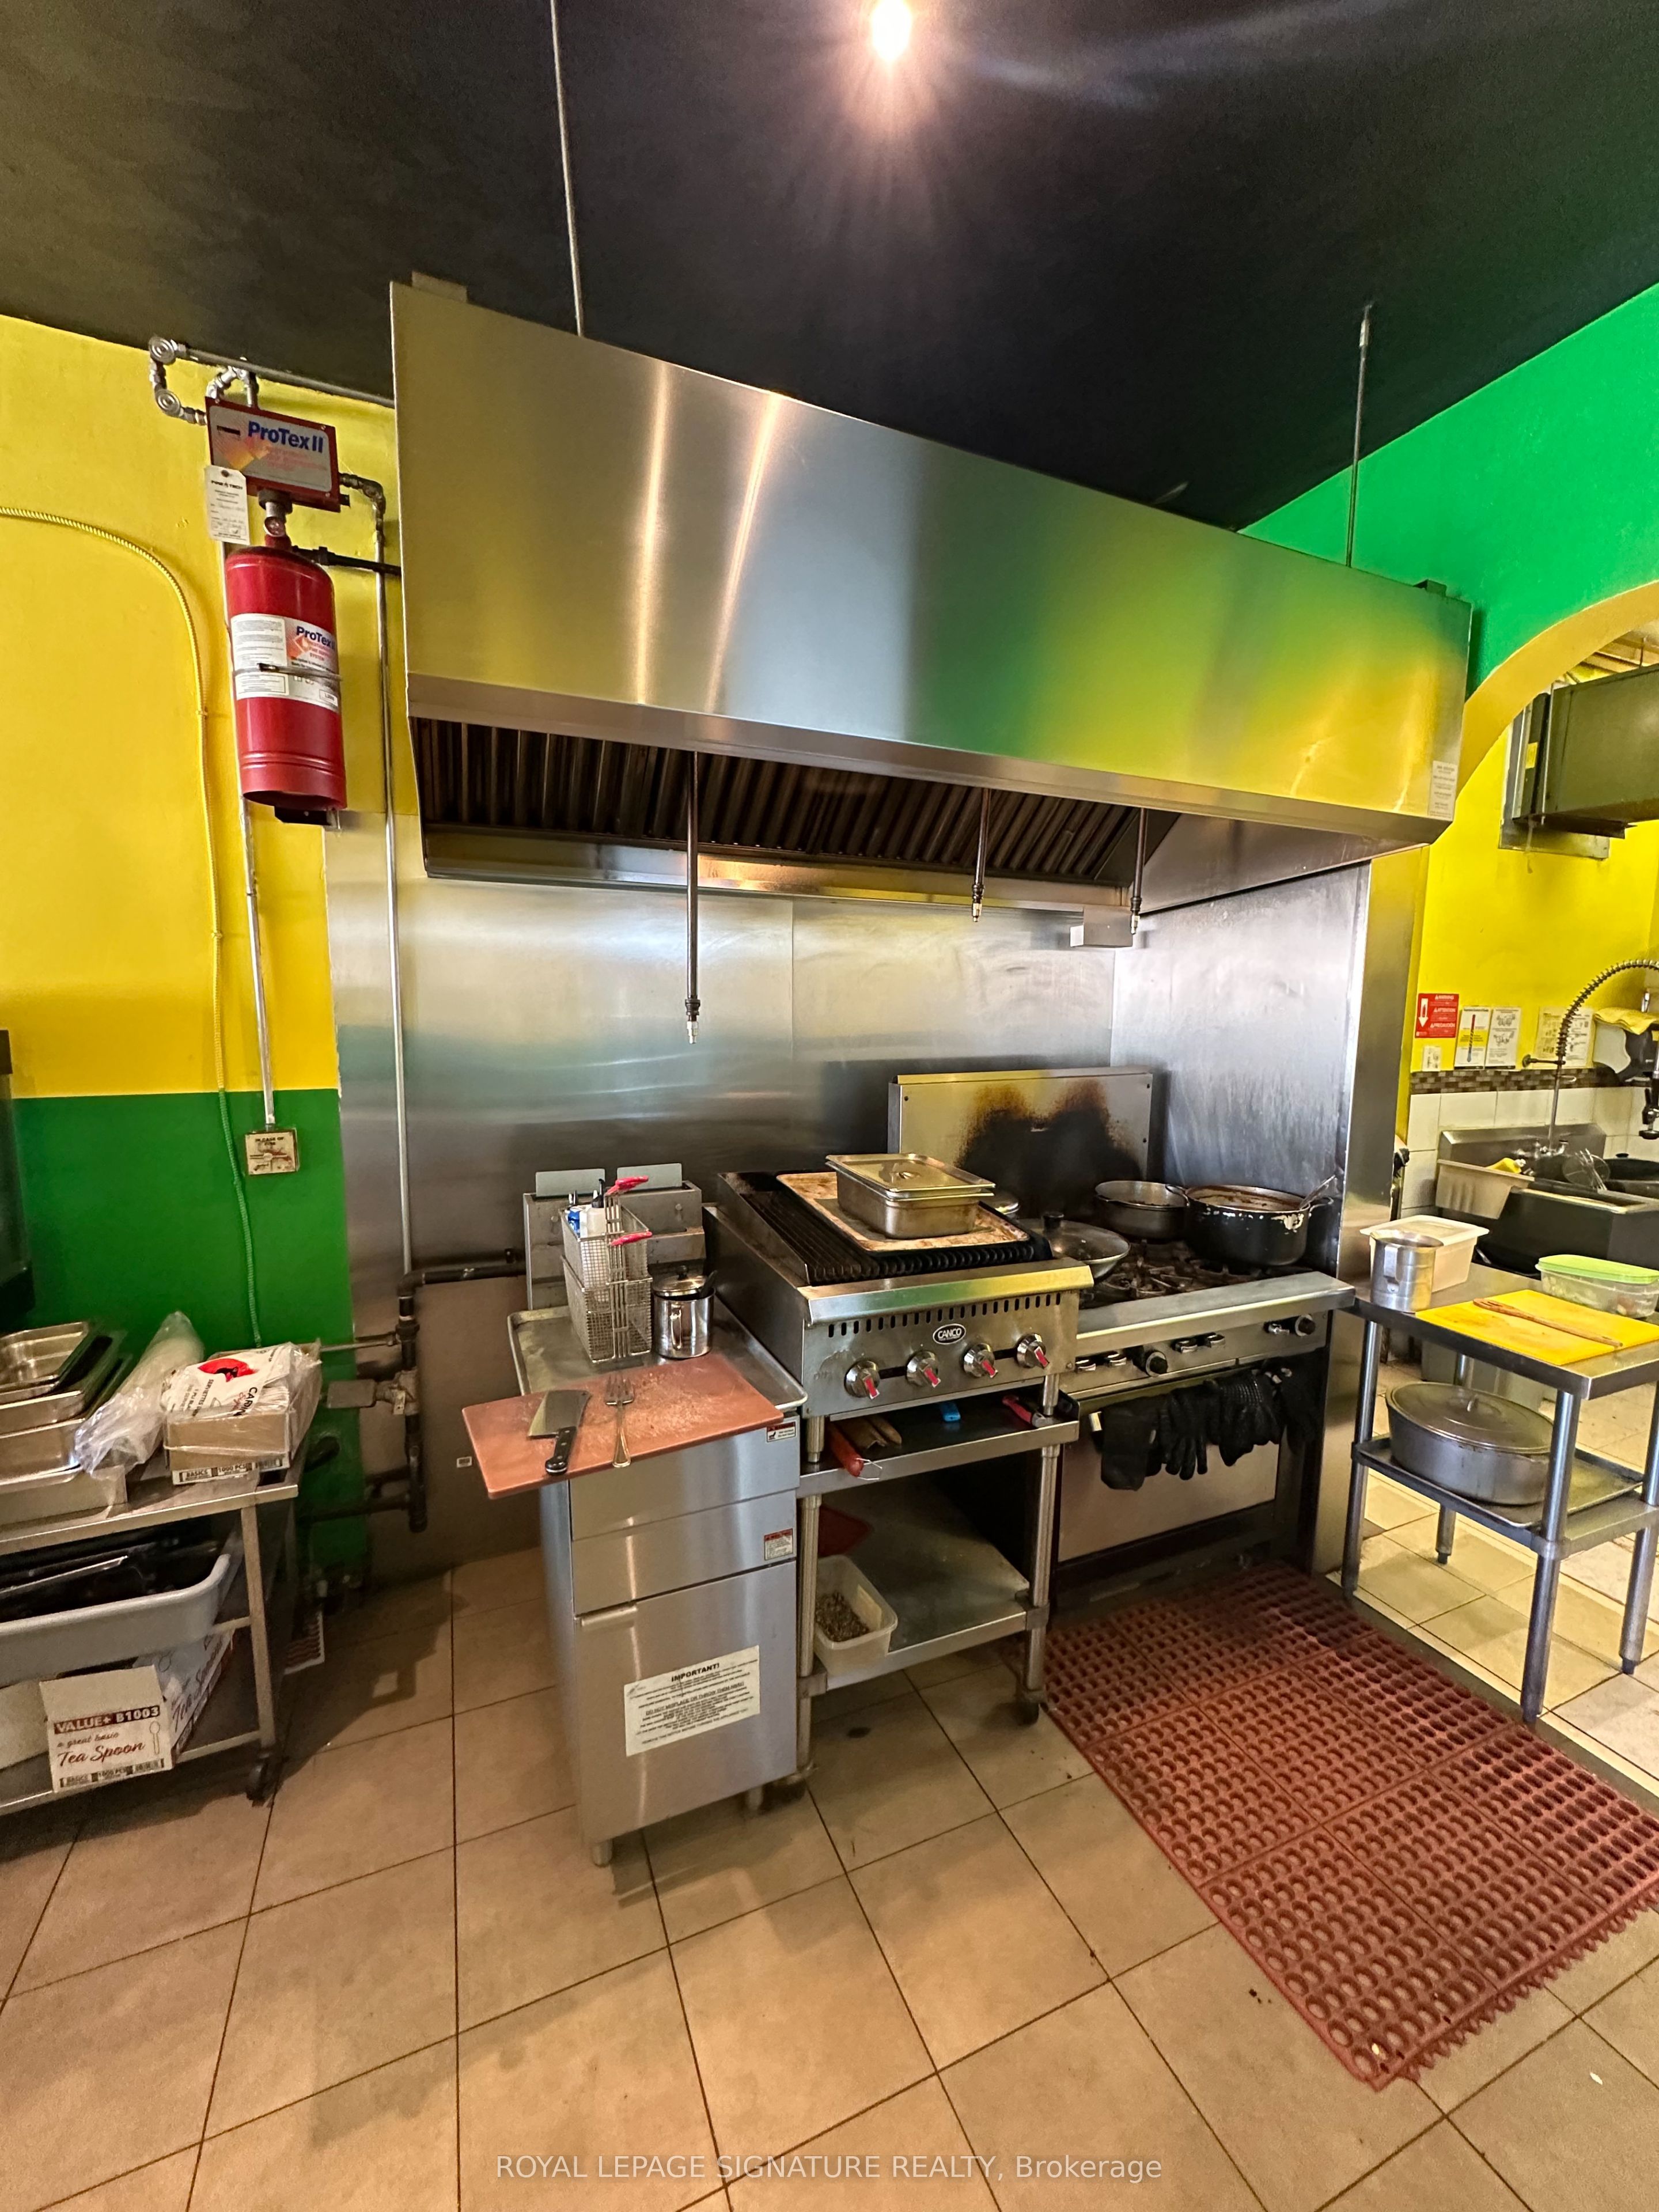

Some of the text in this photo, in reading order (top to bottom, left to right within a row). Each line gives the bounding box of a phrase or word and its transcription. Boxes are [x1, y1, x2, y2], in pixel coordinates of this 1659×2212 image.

[248, 421, 323, 453] ProTex II
[296, 626, 331, 646] ProTex
[937, 1327, 962, 1339] CANCO
[671, 1662, 720, 1682] IMPORTANT!
[116, 1706, 159, 1724] B1003
[67, 1737, 92, 1747] great
[58, 1743, 145, 1767] Tea Spoon
